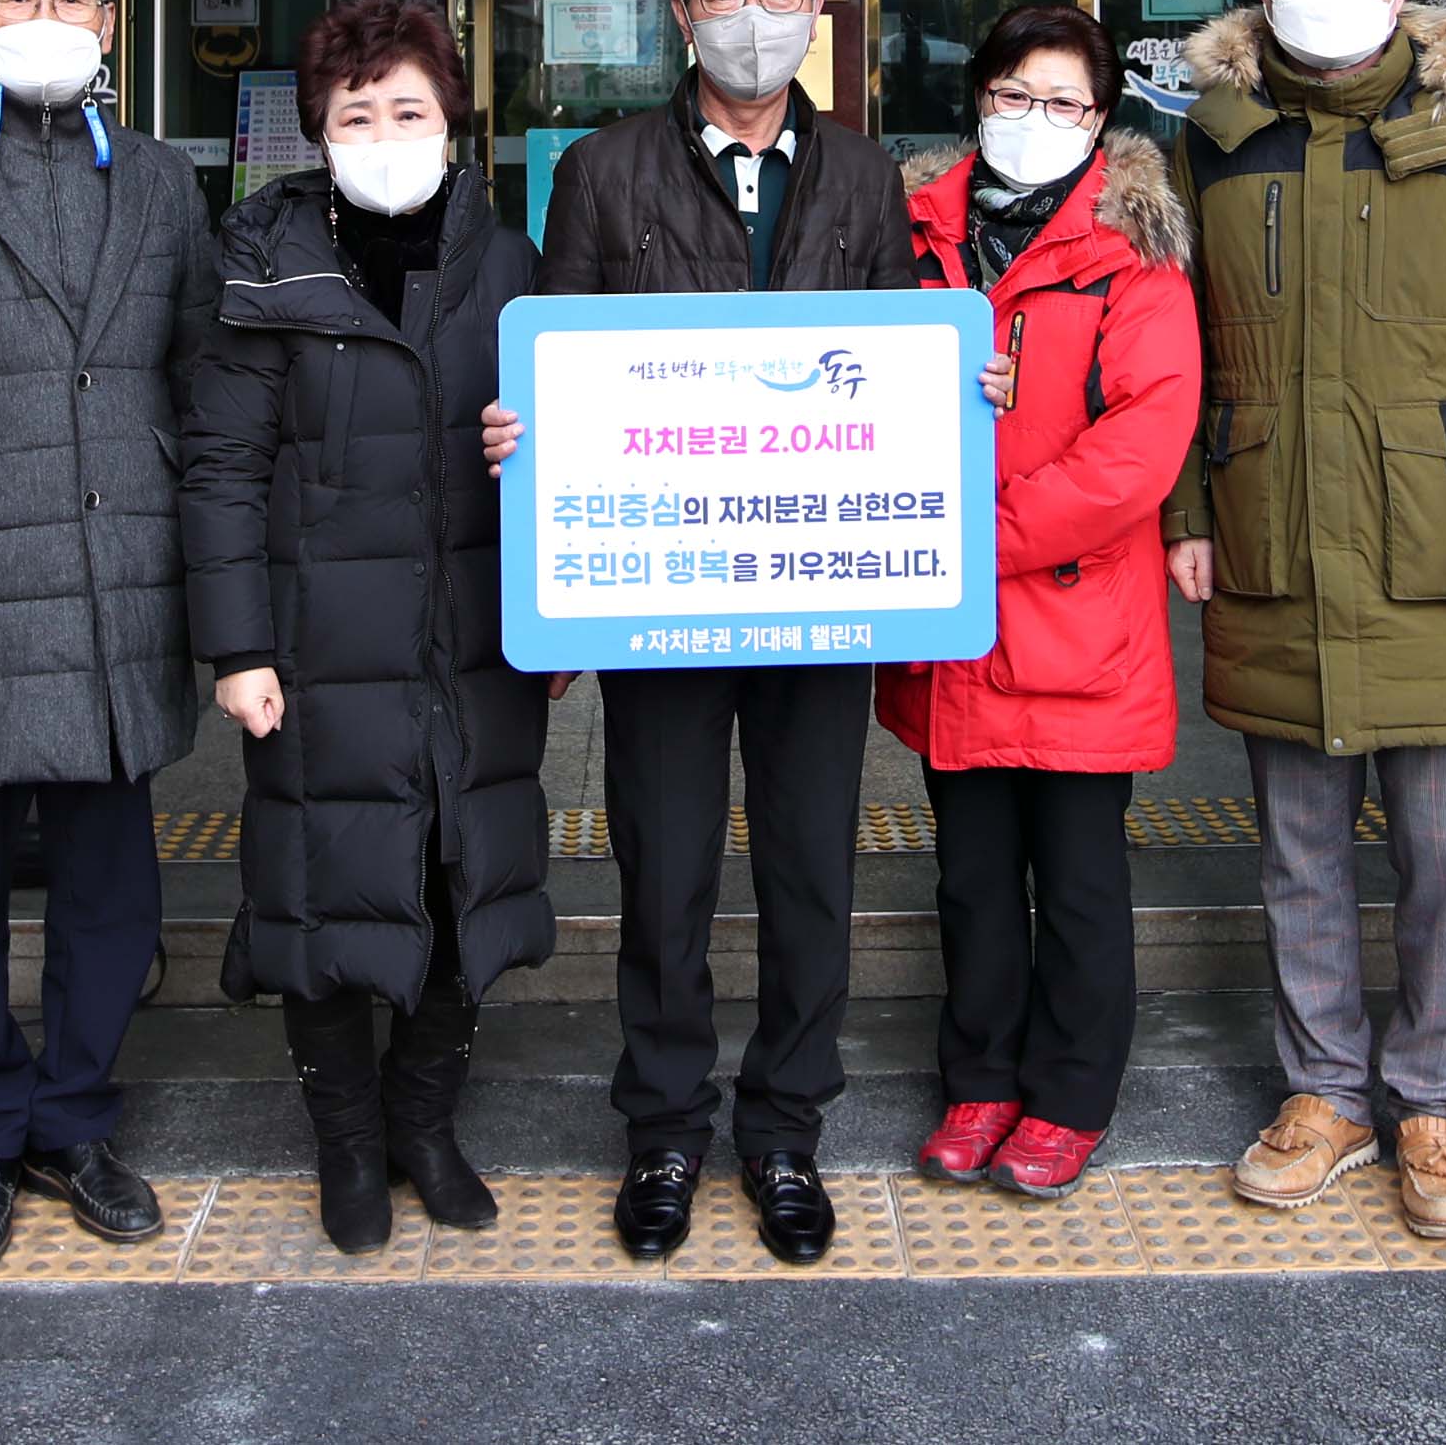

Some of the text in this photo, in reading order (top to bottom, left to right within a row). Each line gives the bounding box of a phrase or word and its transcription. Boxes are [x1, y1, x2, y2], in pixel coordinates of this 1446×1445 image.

[714, 359, 754, 382] 모두가
[759, 358, 804, 381] 행복한
[819, 349, 868, 400] 동구
[623, 422, 875, 456] 자치분권 2.0시대
[553, 492, 946, 529] 주민중심의 자치분권 실현으로
[553, 548, 947, 587] 주민의 행복을 키우겠습니다.
[739, 625, 802, 652] 기대해
[809, 622, 873, 650] 챌린지
